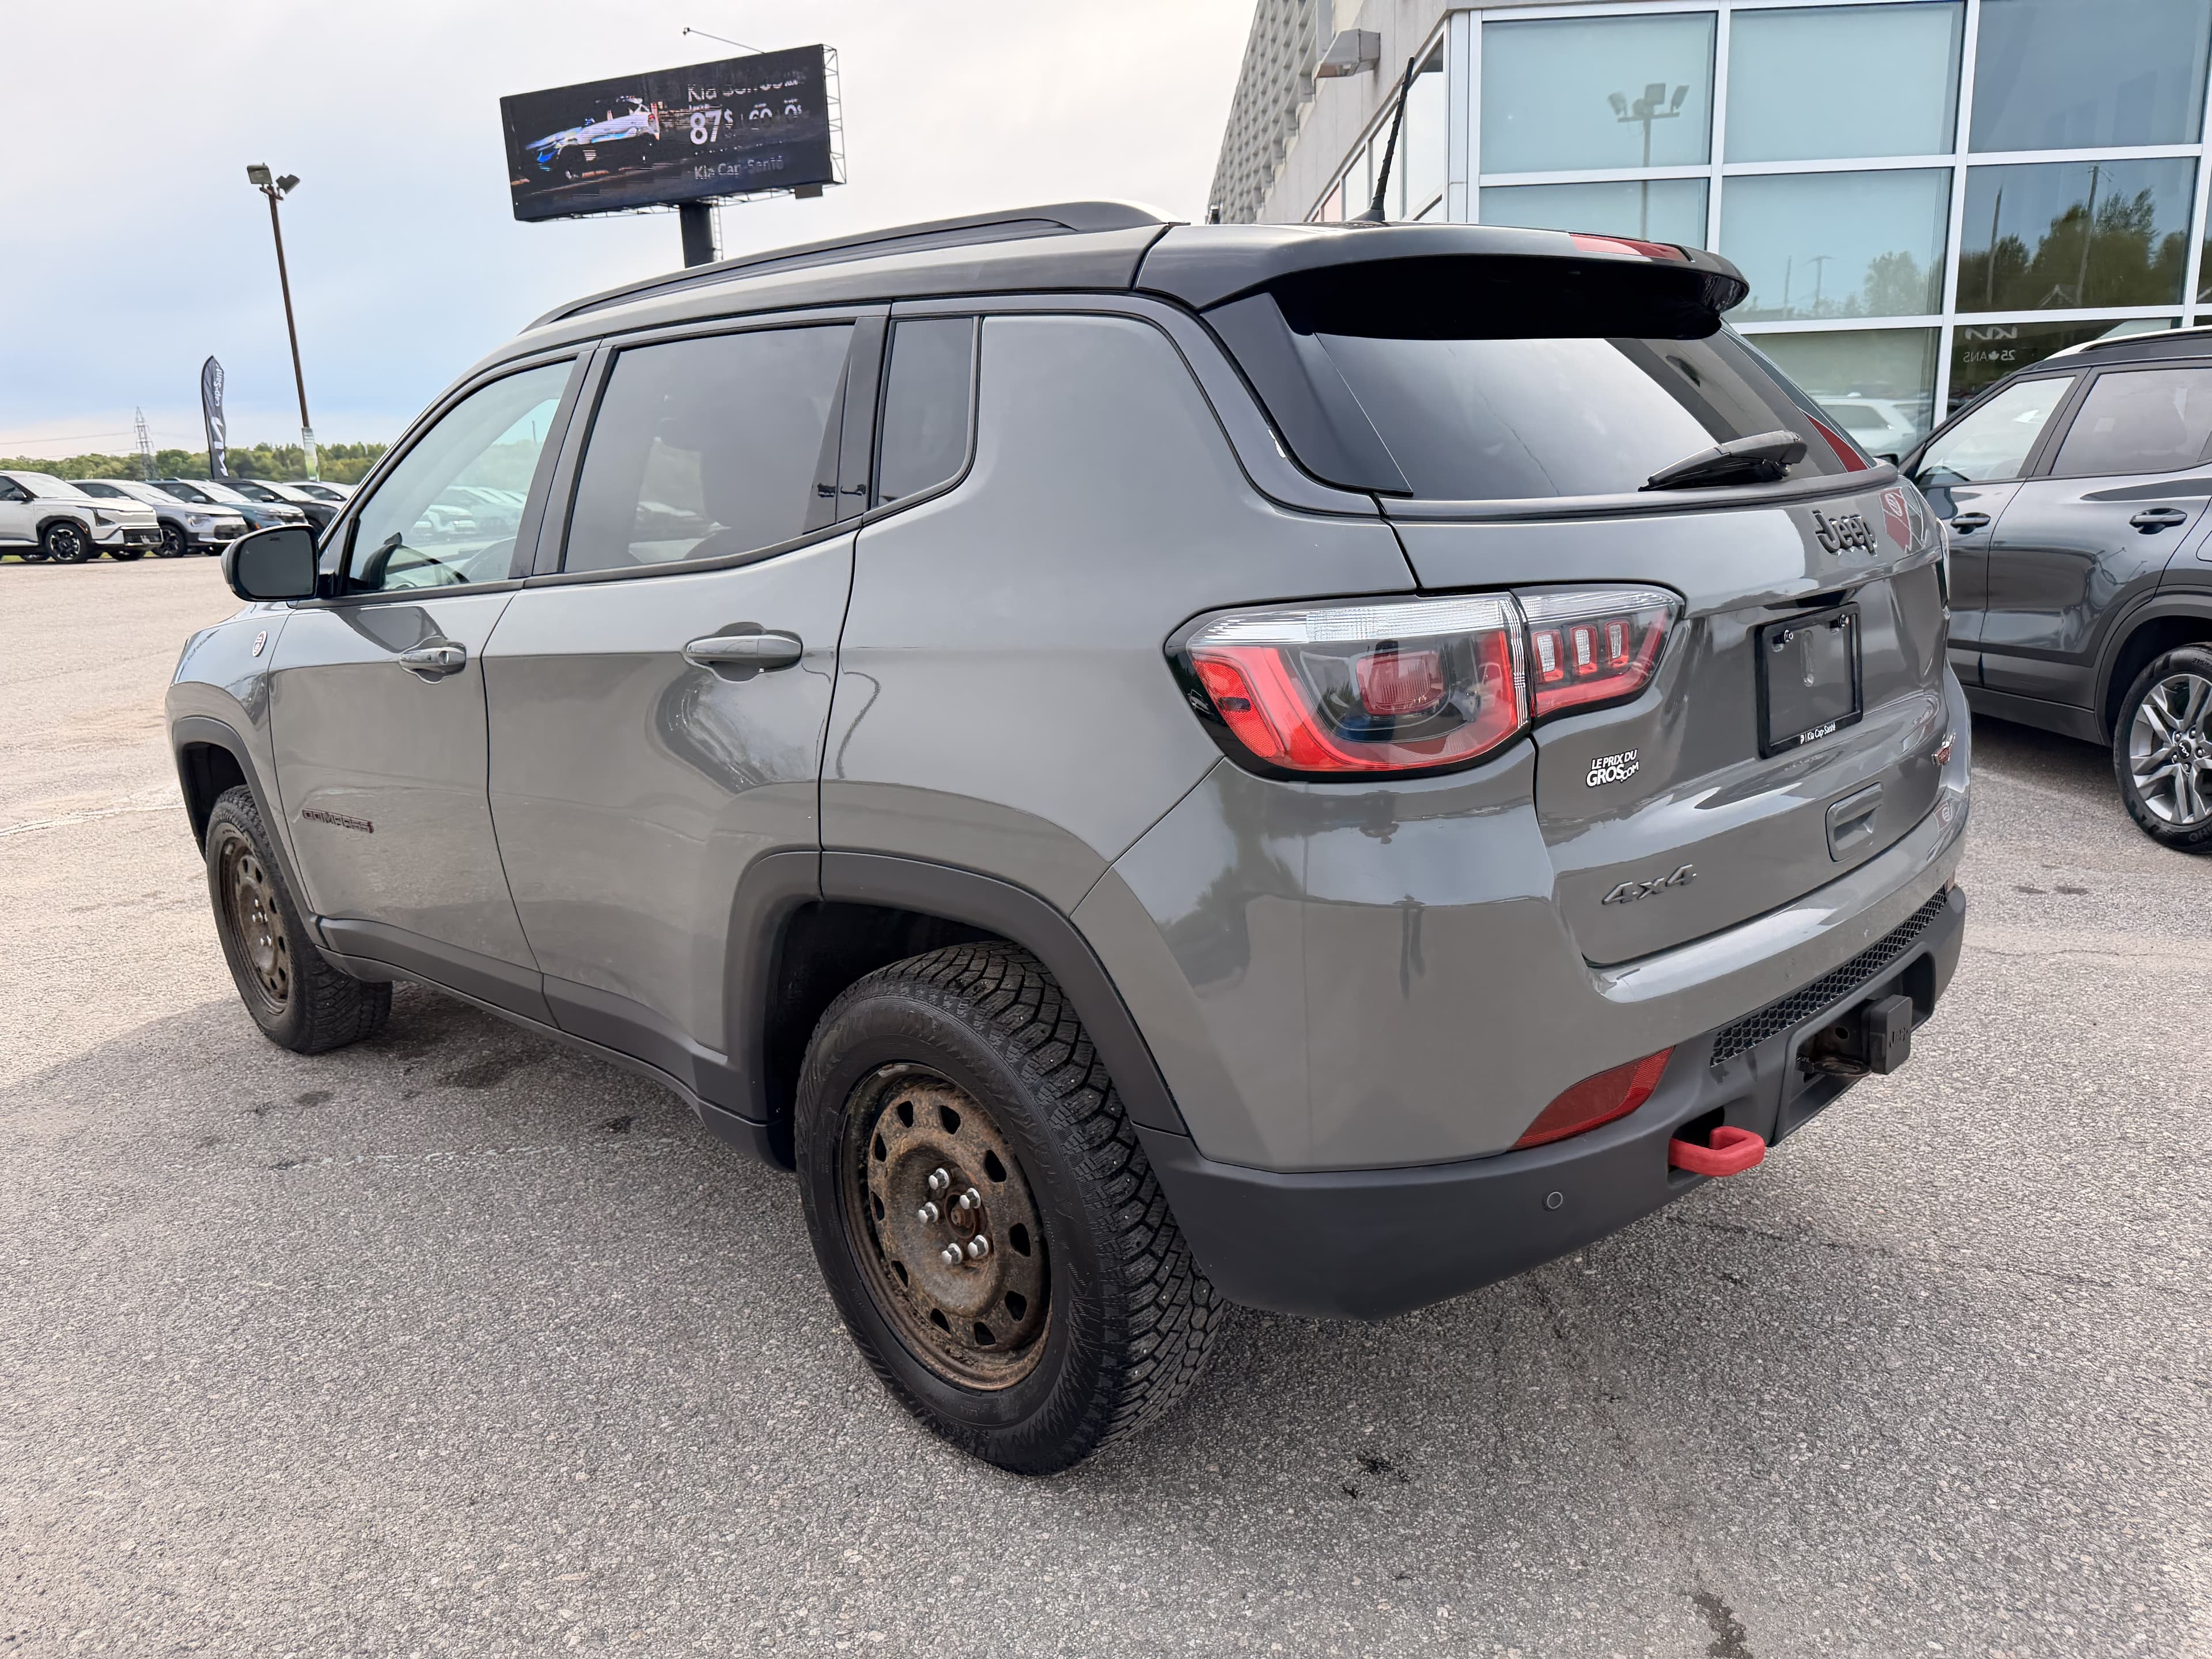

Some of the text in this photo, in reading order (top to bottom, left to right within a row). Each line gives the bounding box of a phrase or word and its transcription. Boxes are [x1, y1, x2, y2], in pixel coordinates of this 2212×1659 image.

[1812, 509, 1877, 557] Jeep
[1591, 749, 1638, 770] LE PRIX DU
